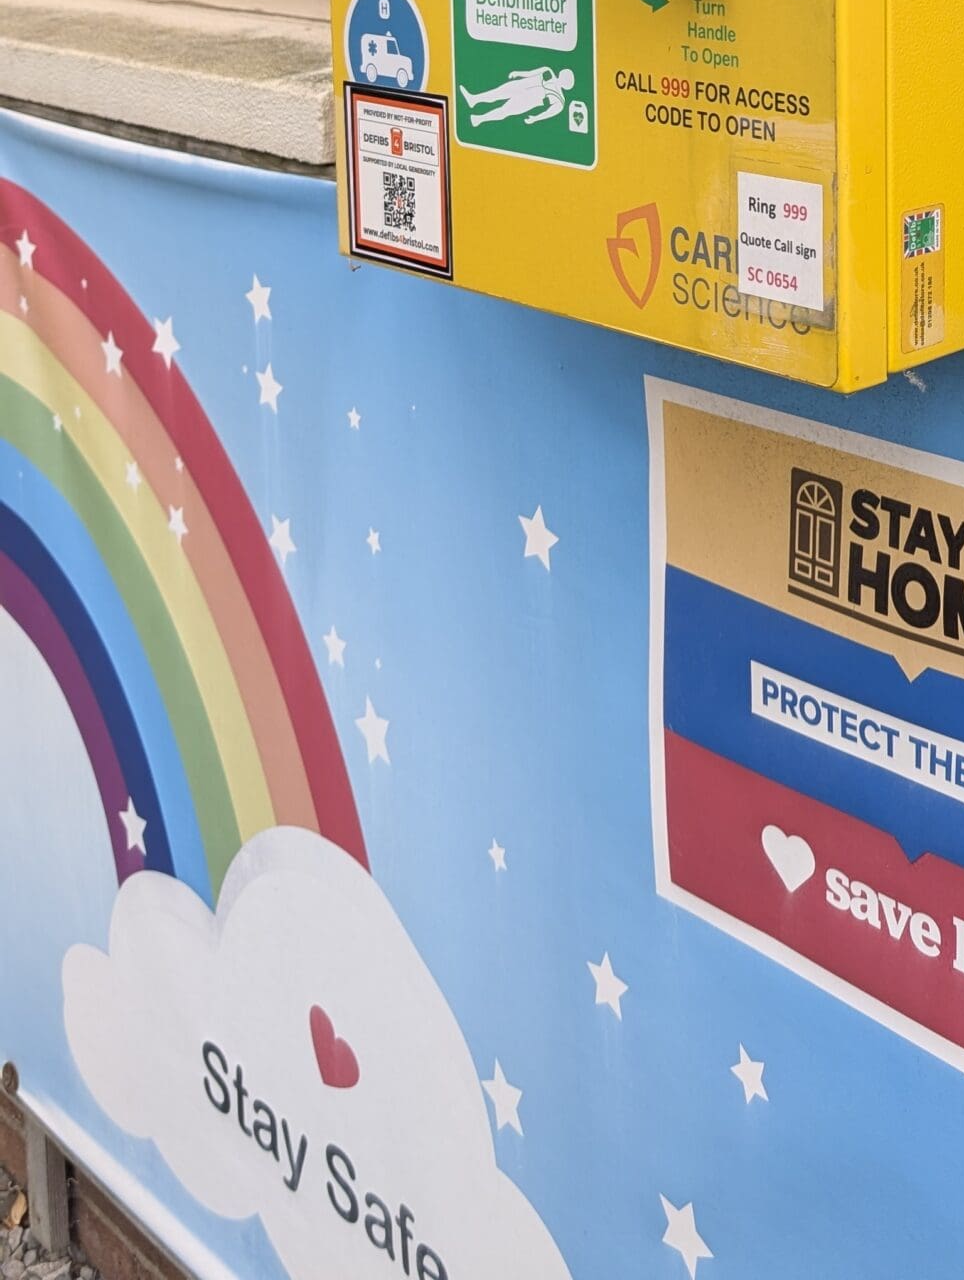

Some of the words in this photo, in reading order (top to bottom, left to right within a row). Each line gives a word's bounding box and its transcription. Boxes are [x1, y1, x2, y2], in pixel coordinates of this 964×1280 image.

[381, 2, 388, 15] H
[476, 9, 507, 27] Heart
[512, 13, 567, 34] Restarter
[687, 21, 736, 42] Handle
[681, 45, 698, 63] To
[702, 47, 739, 69] Open
[615, 70, 657, 94] CALL
[661, 77, 690, 99] 999
[695, 81, 730, 105] FOR
[735, 87, 810, 116] ACCESS
[645, 103, 693, 128] CODE
[697, 111, 721, 132] TO
[726, 116, 775, 142] OPEN
[363, 133, 389, 147] DEFIBS
[404, 141, 435, 156] BRISTOL
[748, 197, 776, 219] Ring
[783, 203, 808, 221] 999
[363, 226, 439, 254] www.defibs4bristol.com
[740, 231, 771, 250] Quote
[774, 239, 793, 254] Call
[795, 244, 816, 260] sign
[748, 267, 763, 283] SC
[766, 273, 798, 292] 0654
[762, 677, 899, 759] PROTECT
[826, 868, 941, 958] save
[202, 1040, 308, 1192] Stay
[326, 1143, 449, 1280] Safe
